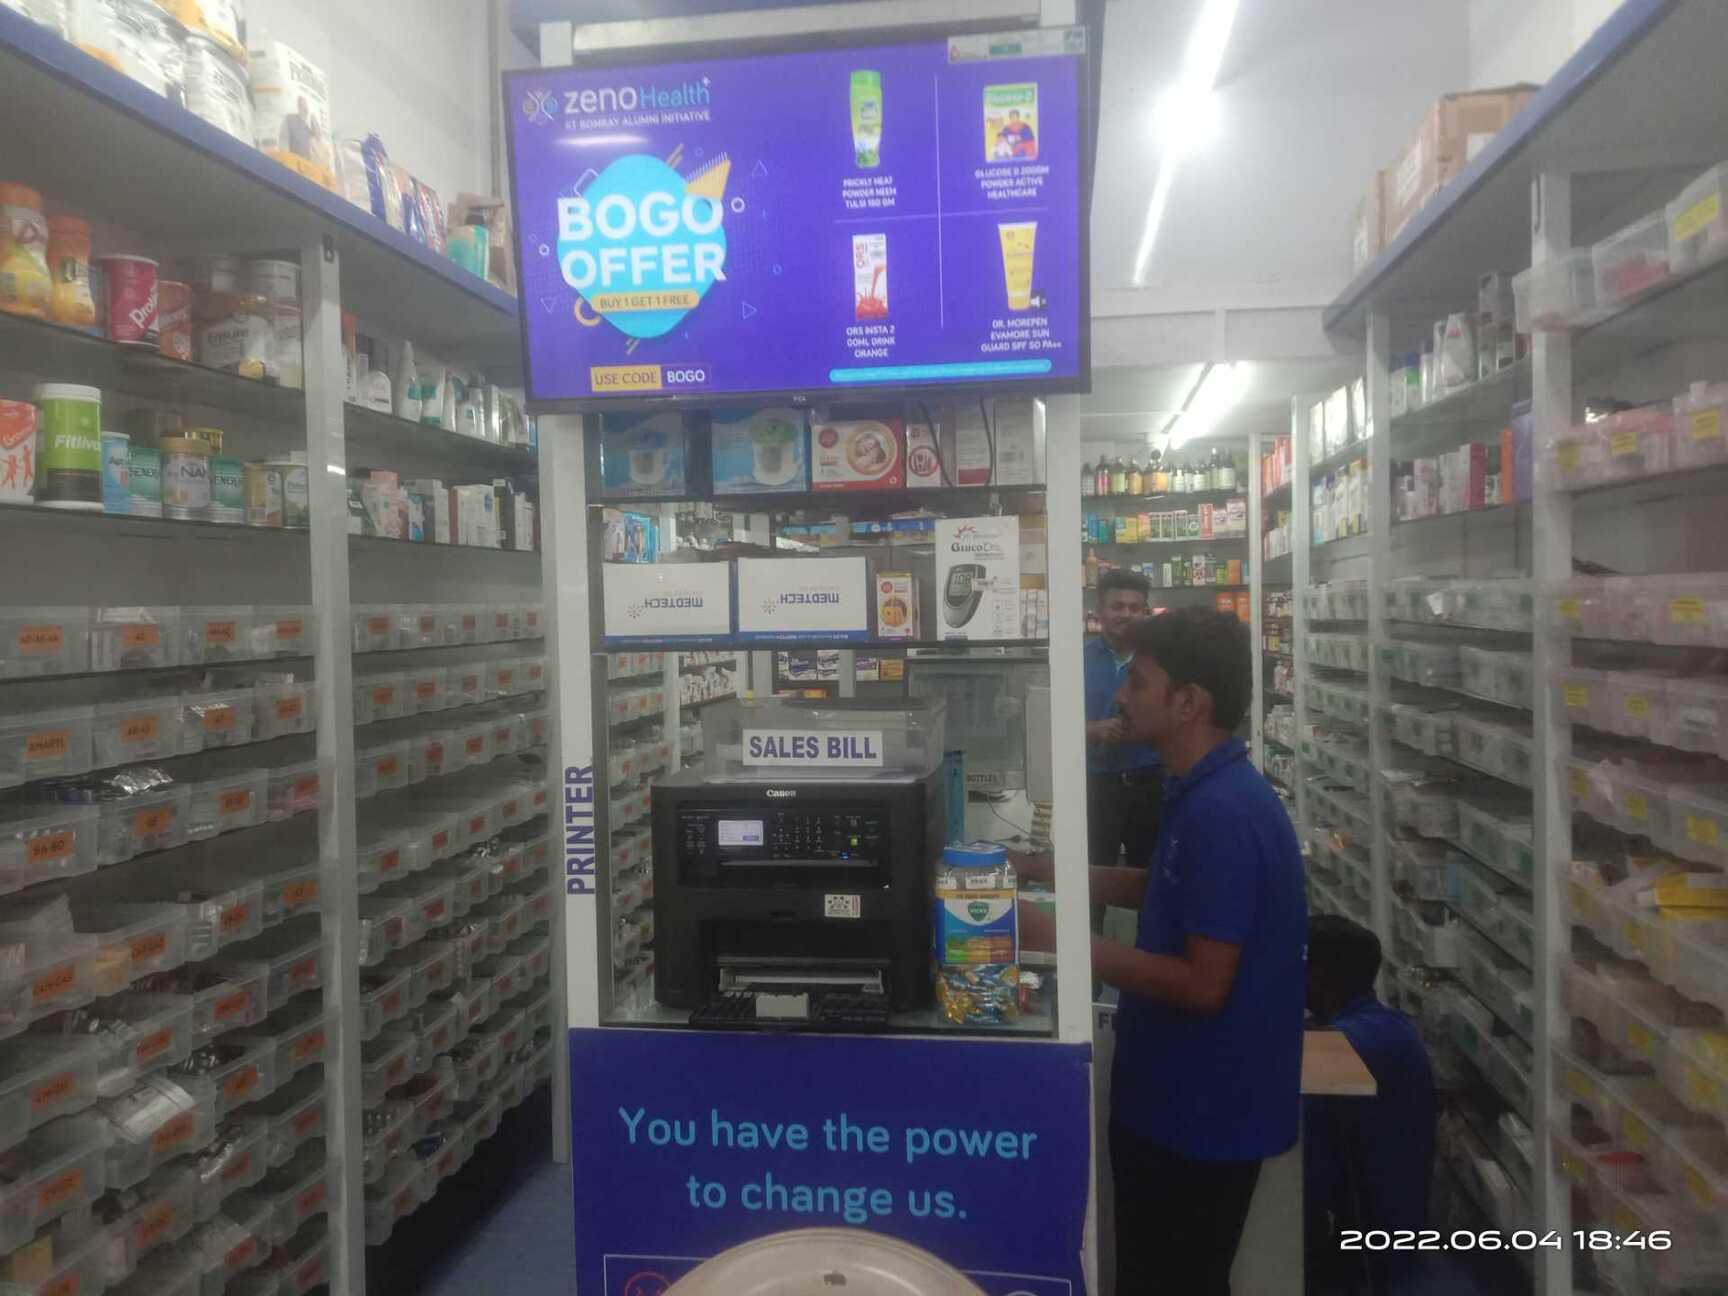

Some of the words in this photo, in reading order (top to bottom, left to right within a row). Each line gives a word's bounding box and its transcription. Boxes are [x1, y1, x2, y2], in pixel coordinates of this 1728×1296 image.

[580, 117, 619, 129] BOMBAY
[622, 114, 659, 126] ALUMNI
[661, 111, 710, 123] INITIATIVE
[974, 167, 1011, 178] GLUCOSE
[843, 177, 872, 187] PRICKLY
[873, 176, 893, 186] HEAT
[980, 179, 1014, 189] POWDER
[1015, 177, 1043, 187] ACTIVE
[842, 188, 874, 198] POWDER
[987, 188, 1037, 199] HEALTHCARE
[846, 199, 867, 209] TULSI
[557, 191, 724, 241] BOGO
[561, 242, 727, 289] OFFER
[600, 296, 624, 308] BUY
[630, 295, 655, 307] GET
[661, 294, 689, 306] FREE
[1007, 317, 1048, 327] MOREPEN
[846, 327, 864, 336] ORS
[865, 326, 889, 335] INSTA
[991, 330, 1029, 340] EVAMORE
[1032, 328, 1050, 338] SUN
[871, 336, 896, 346] DRINK
[981, 342, 1010, 353] GUARD
[1011, 341, 1026, 351] SPF
[854, 348, 888, 358] ORANGE
[594, 372, 619, 386] USE
[622, 371, 657, 385] CODE
[667, 370, 705, 384] BOGO
[645, 598, 703, 608] MEDTECH
[780, 593, 840, 604] MEDTECH
[750, 736, 820, 759] SALES
[827, 737, 877, 759] BILL
[766, 789, 797, 798] Canon
[565, 767, 596, 894] PRINTER
[618, 1106, 696, 1146] You
[711, 1109, 809, 1150] have
[823, 1112, 890, 1152] the
[906, 1126, 1037, 1164] power
[686, 1175, 727, 1209] to
[740, 1171, 893, 1224] change
[908, 1190, 967, 1219] us.
